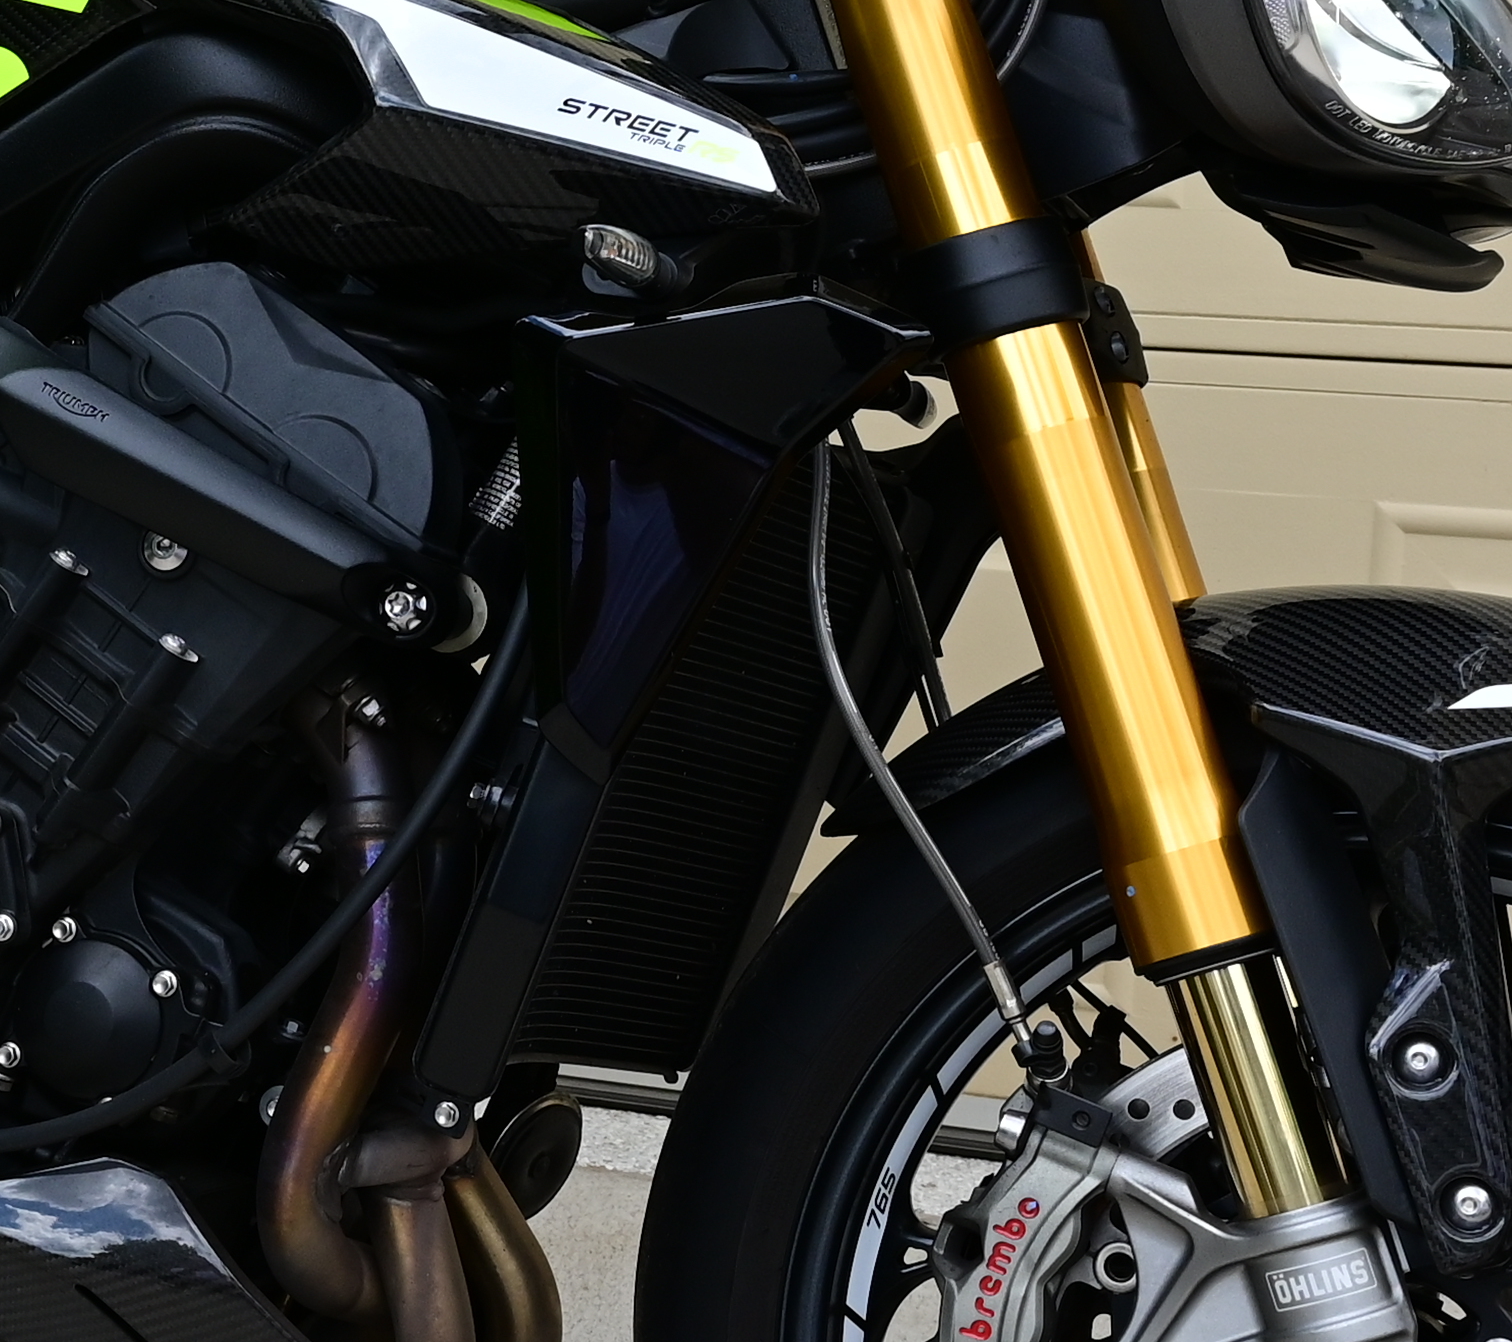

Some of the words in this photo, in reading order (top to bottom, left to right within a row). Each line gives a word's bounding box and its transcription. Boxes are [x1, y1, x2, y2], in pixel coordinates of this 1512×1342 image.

[557, 98, 699, 142] STREET
[1349, 116, 1373, 133] LED
[629, 132, 686, 153] TRIPLE
[687, 140, 741, 163] RS
[41, 381, 110, 422] TRIUMPH
[866, 1166, 897, 1230] 765
[959, 1197, 1041, 1341] brembo
[1272, 1260, 1369, 1304] ÖHLINS
